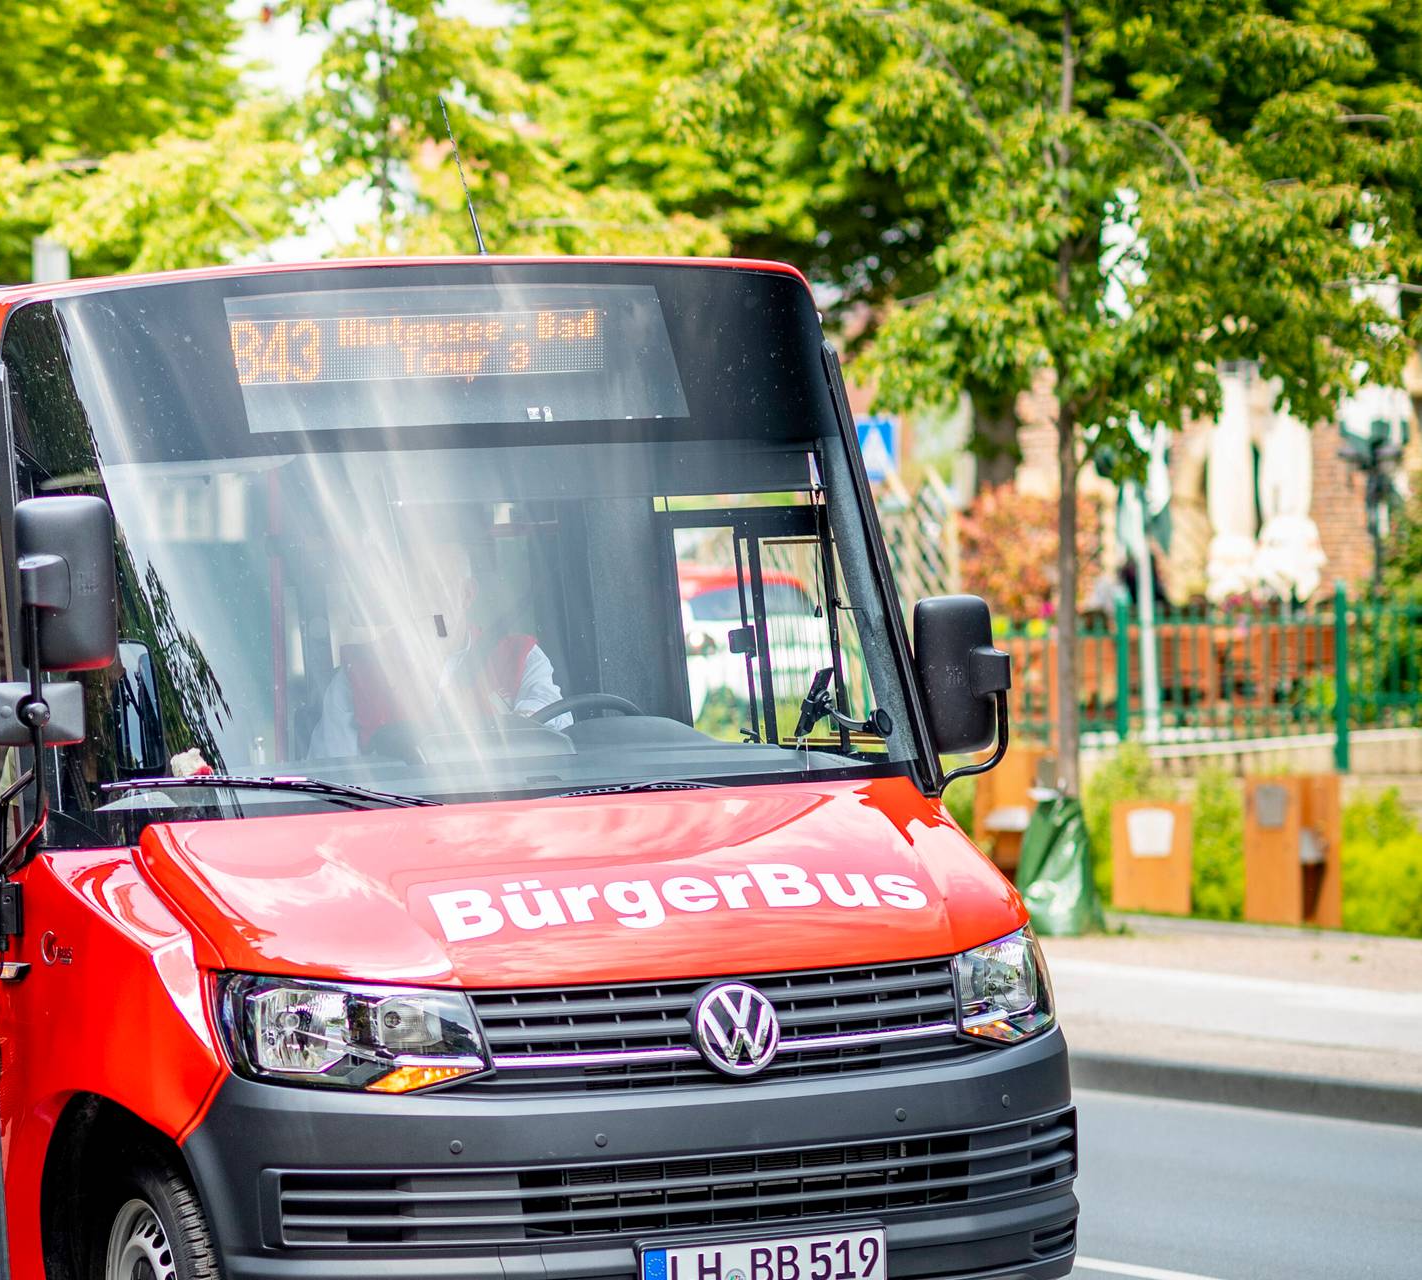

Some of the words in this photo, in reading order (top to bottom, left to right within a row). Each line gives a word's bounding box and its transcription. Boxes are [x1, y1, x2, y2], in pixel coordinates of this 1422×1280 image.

[537, 308, 595, 340] Bad
[399, 346, 490, 375] Tour
[508, 340, 530, 370] 3
[428, 863, 928, 942] BürgerBus
[750, 1244, 800, 1280] BB
[810, 1237, 879, 1280] 519
